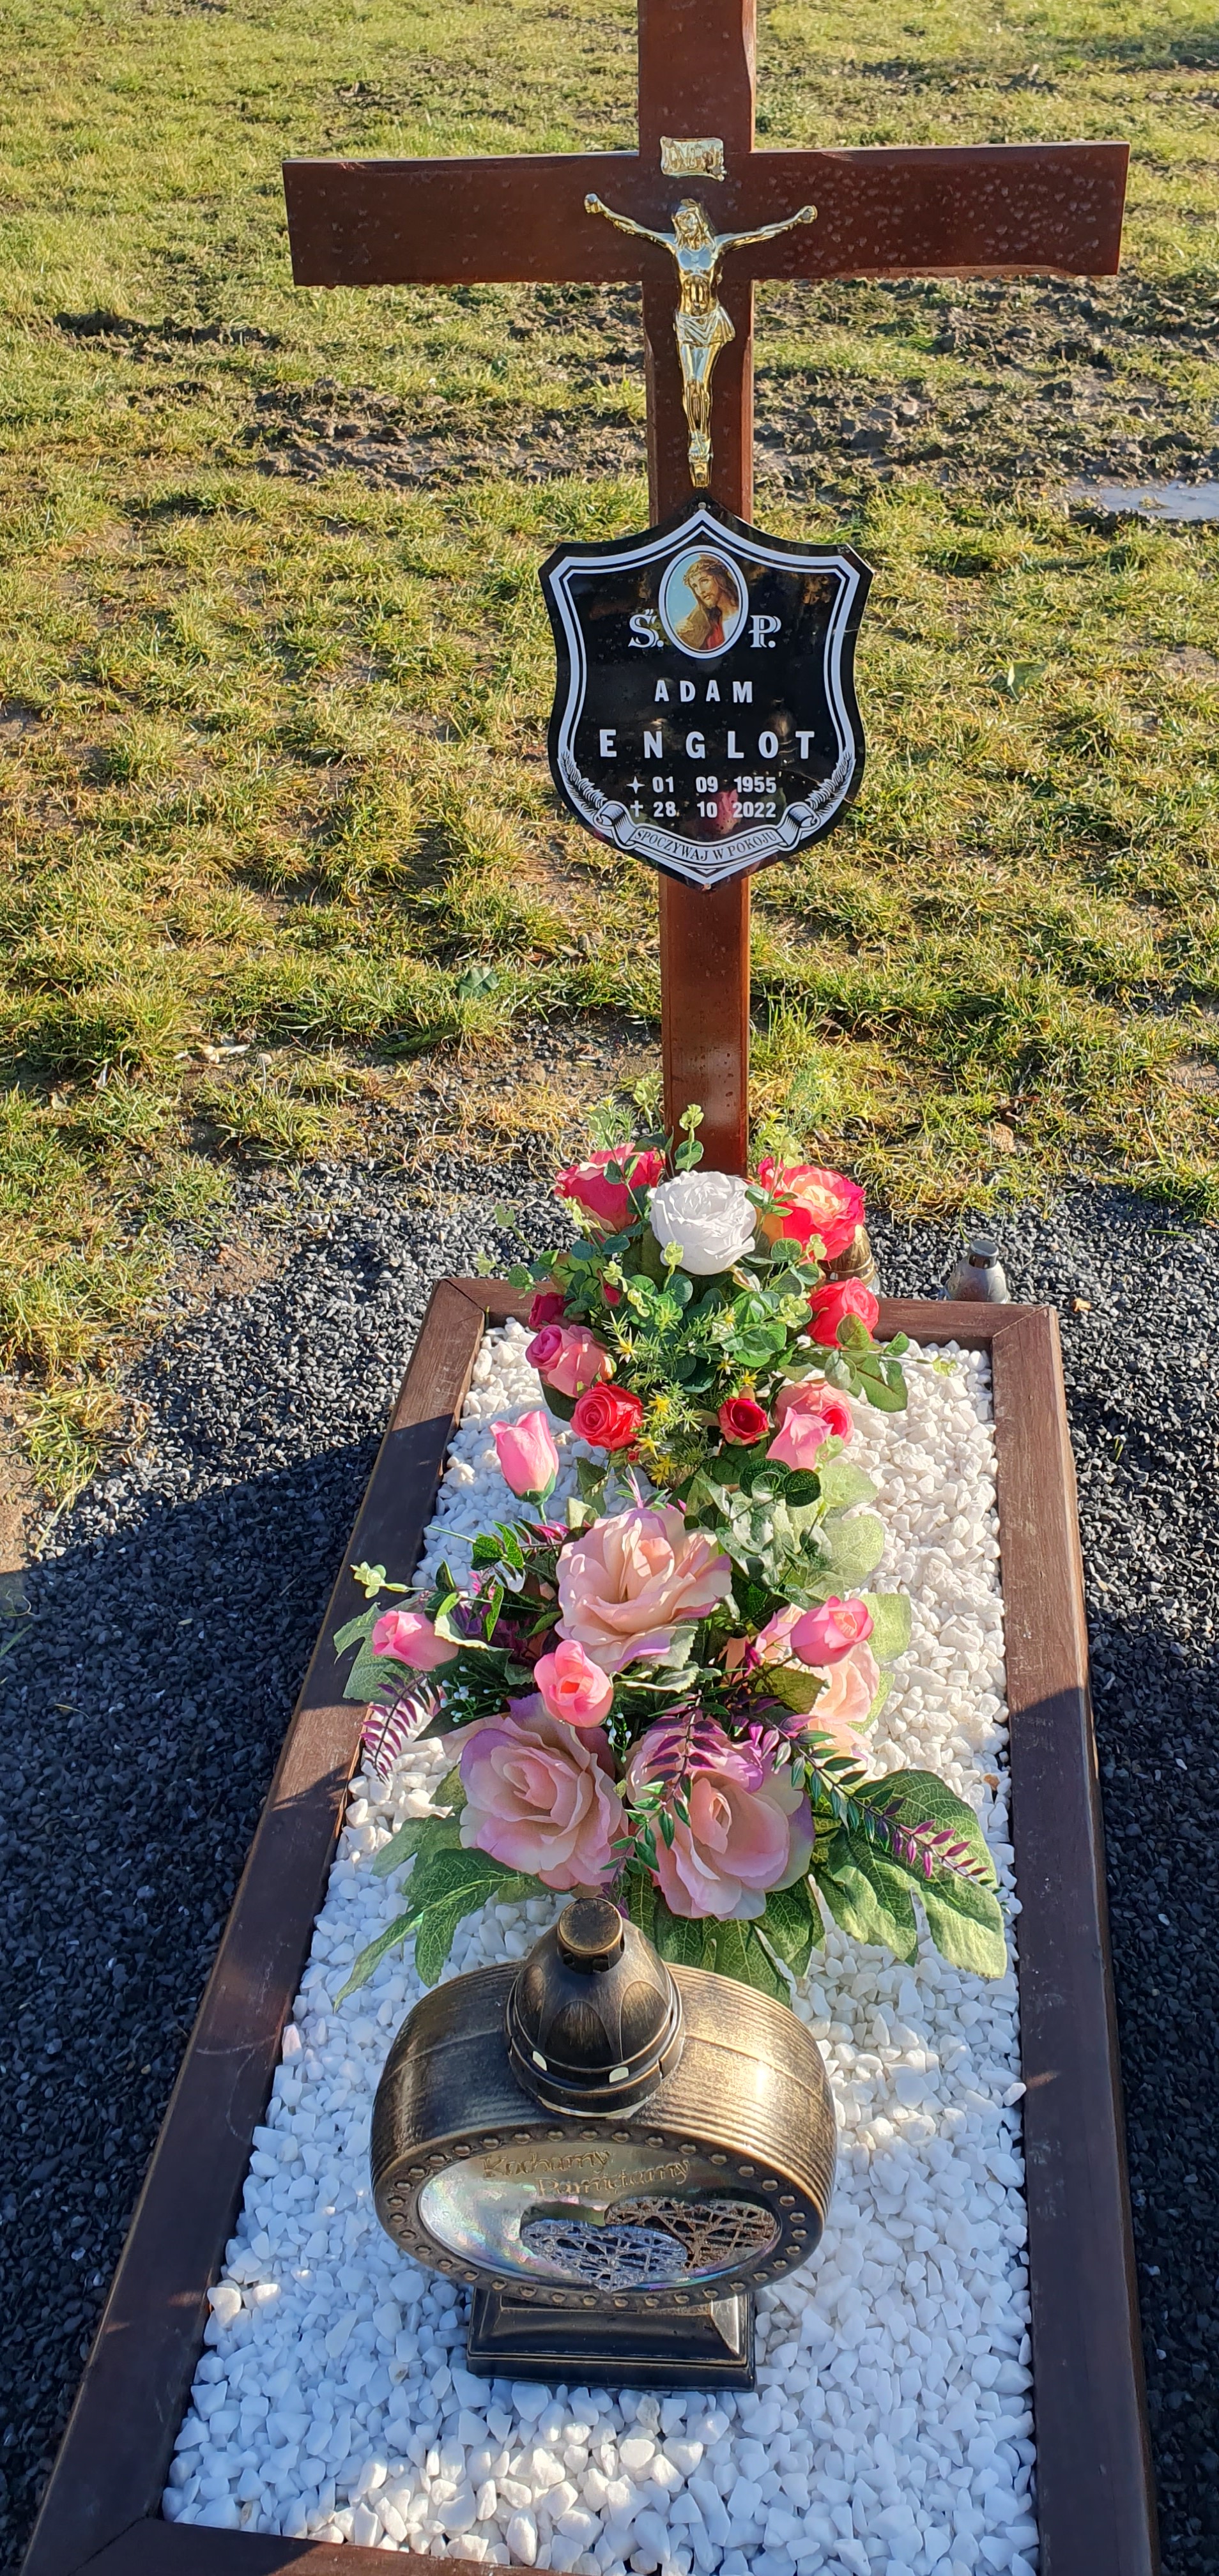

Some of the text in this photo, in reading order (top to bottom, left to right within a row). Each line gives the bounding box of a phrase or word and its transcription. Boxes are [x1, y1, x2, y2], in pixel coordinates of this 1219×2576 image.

[748, 615, 781, 648] P.
[654, 680, 753, 703] ADAM
[599, 729, 815, 759] ENGLOT
[652, 776, 776, 793] 01 09 1955
[654, 802, 776, 818] 28 10 2022
[634, 830, 777, 861] SPOCZYWAJ W POKOJU
